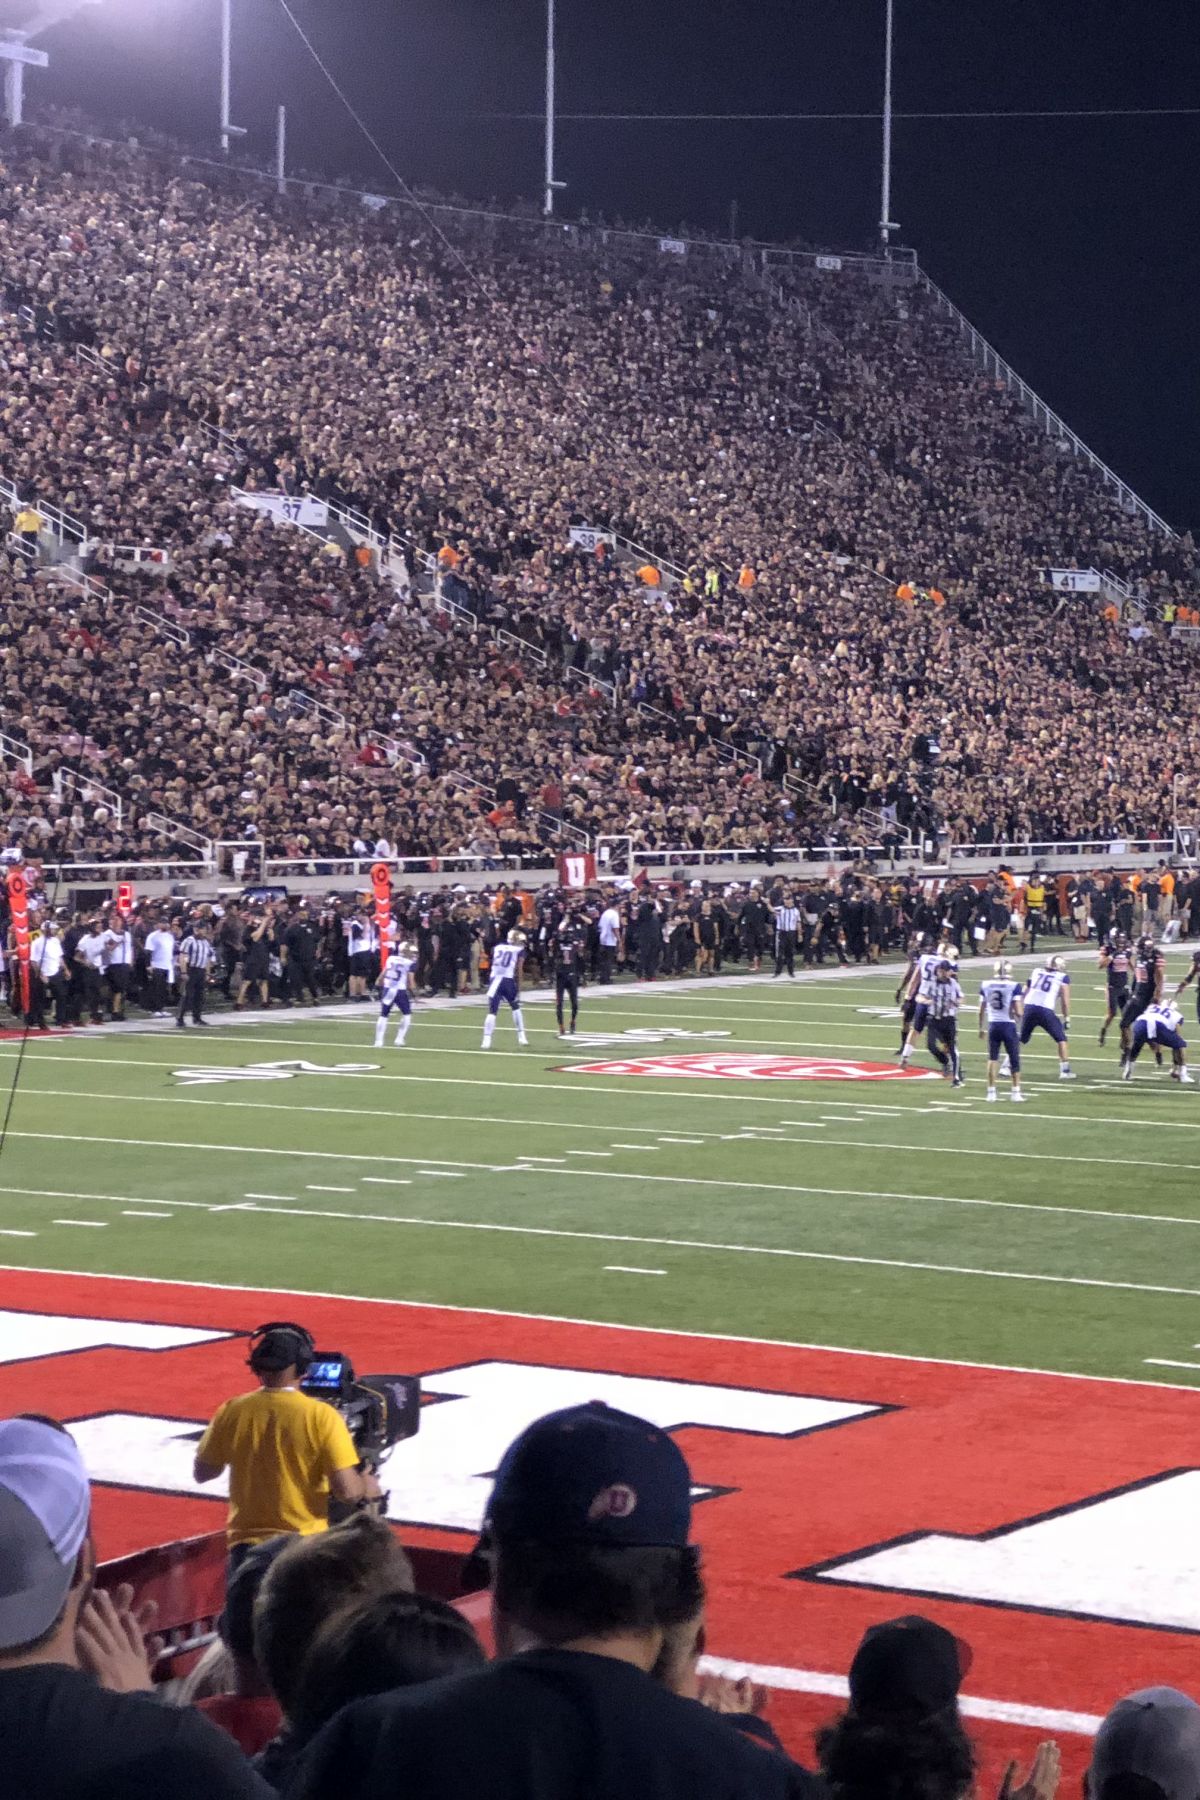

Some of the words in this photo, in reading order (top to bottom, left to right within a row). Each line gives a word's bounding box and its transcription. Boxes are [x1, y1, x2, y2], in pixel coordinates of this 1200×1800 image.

[283, 503, 301, 521] 37
[1032, 973, 1054, 992] 76
[990, 991, 1004, 1010] 3
